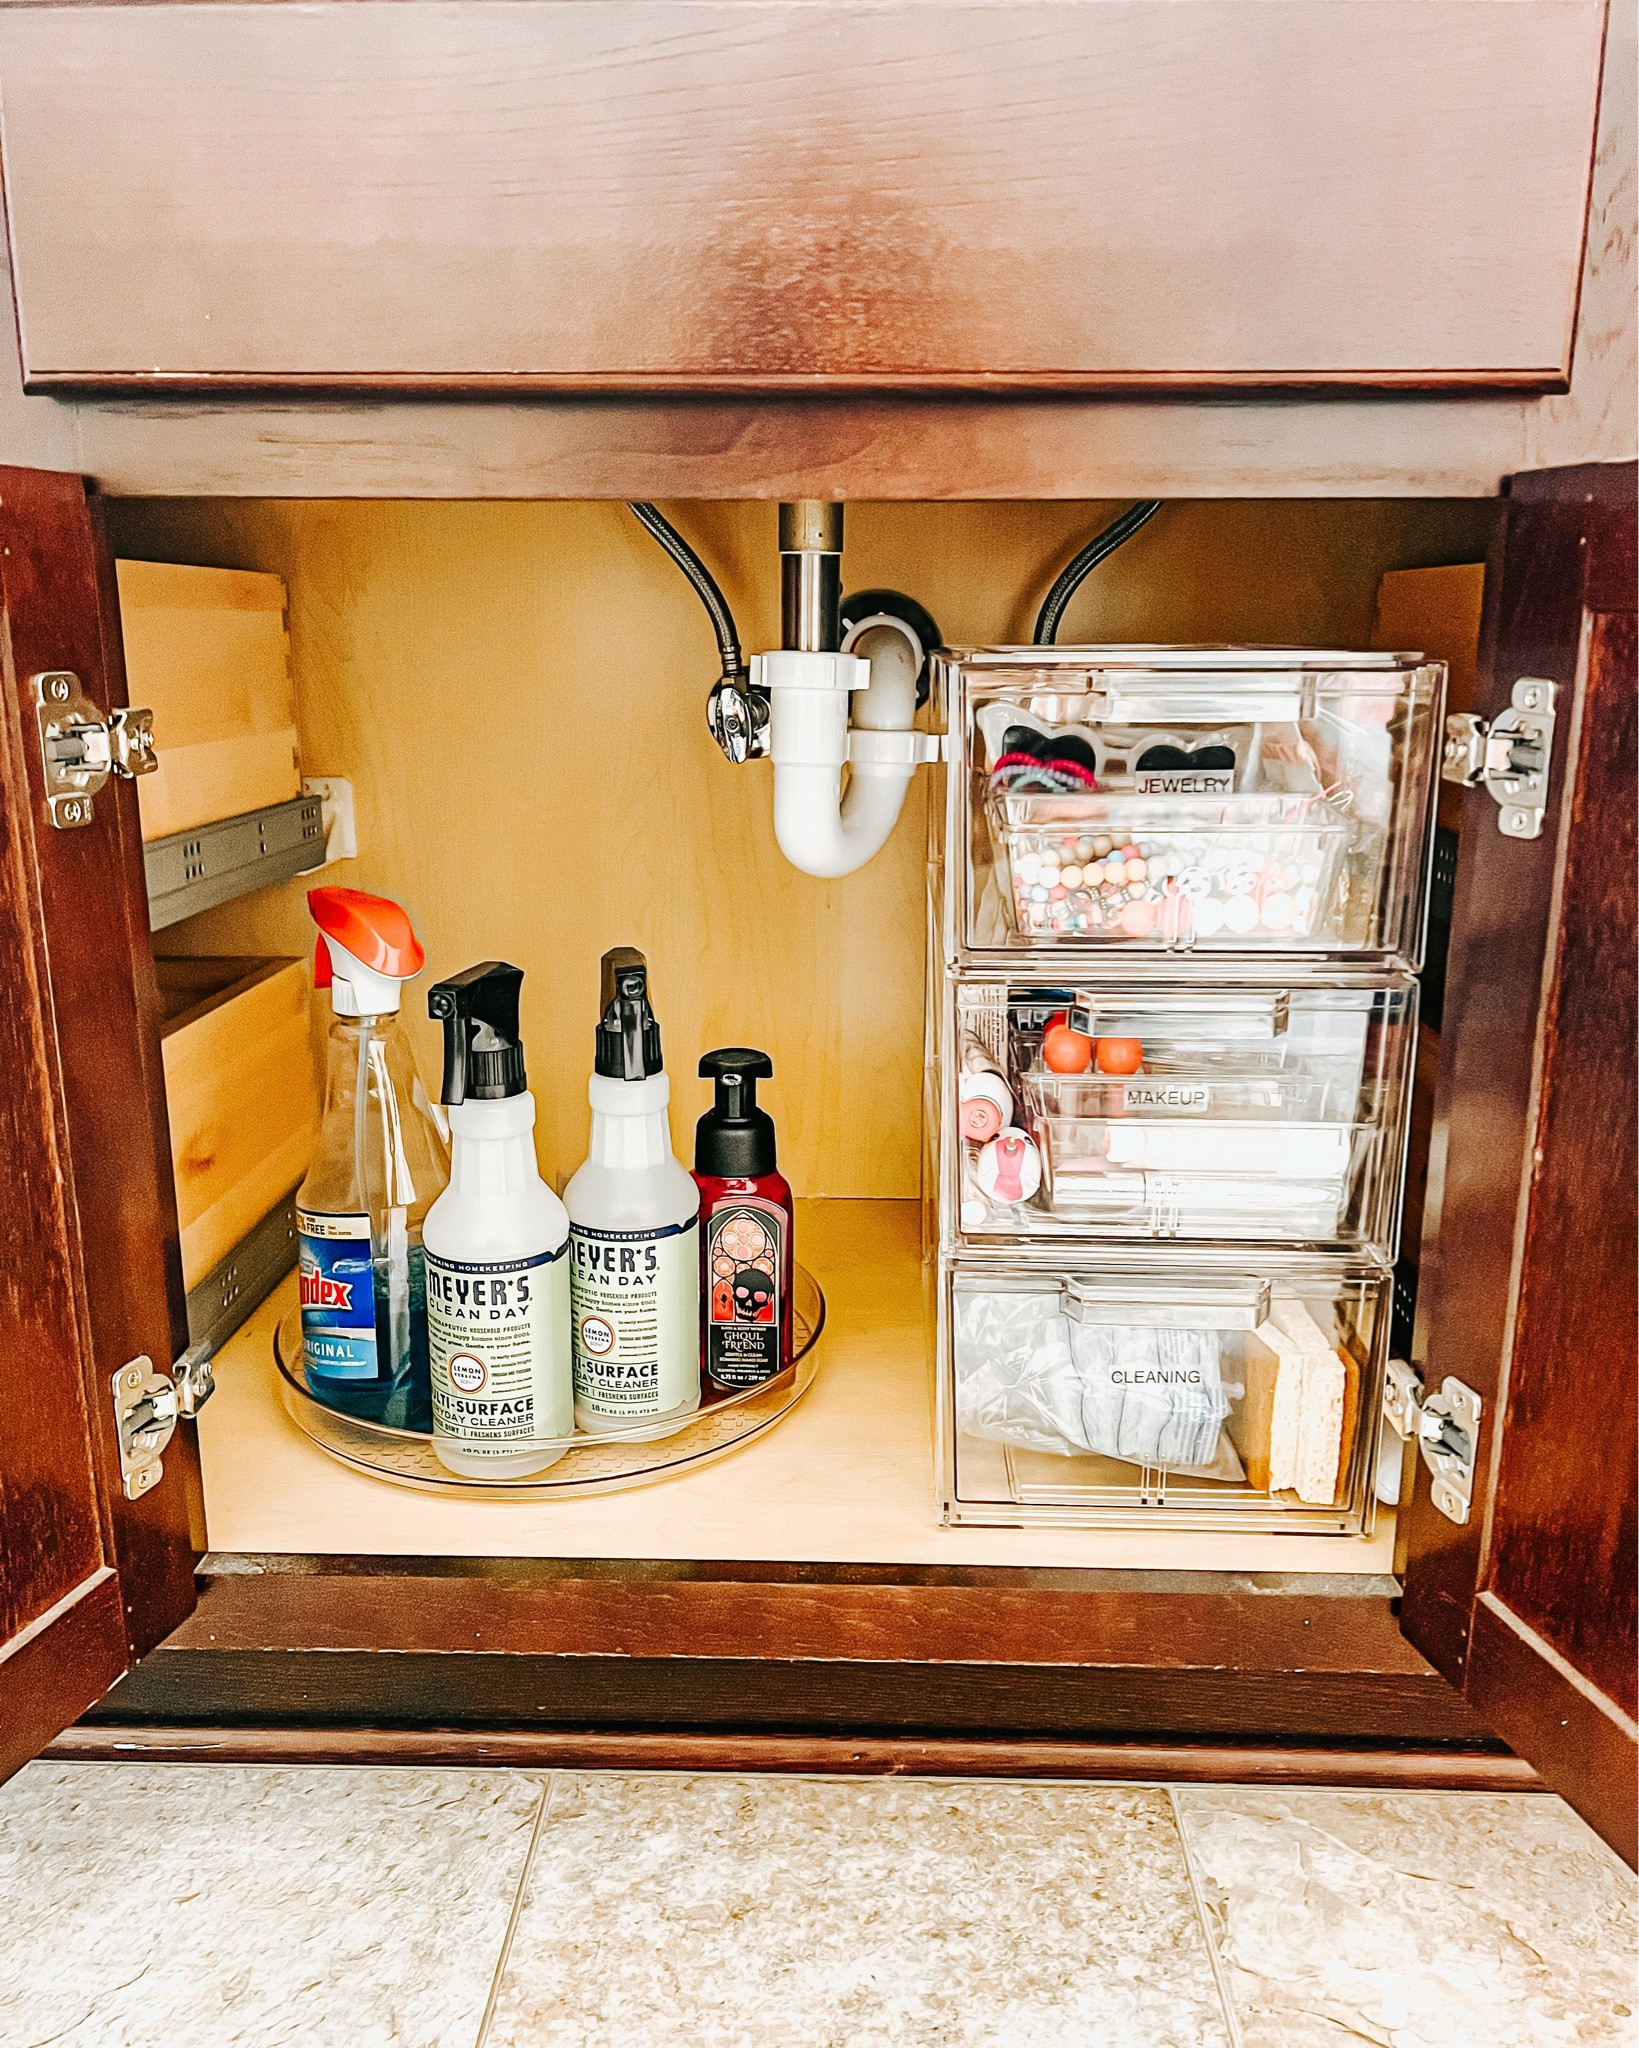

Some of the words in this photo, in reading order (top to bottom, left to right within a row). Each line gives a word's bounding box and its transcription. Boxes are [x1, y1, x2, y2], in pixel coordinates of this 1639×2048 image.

[1138, 777, 1230, 794] JEWELRY
[1127, 1090, 1205, 1105] MAKEUP
[306, 1223, 326, 1235] FREE
[591, 1231, 656, 1240] HOMEKEEPING
[459, 1261, 528, 1272] HOMEKEEPING
[618, 1274, 657, 1286] DAY
[631, 1290, 657, 1299] PRODUCTS
[430, 1297, 481, 1320] CLEAN
[490, 1304, 530, 1320] DAY
[503, 1322, 531, 1332] PRODUCTS
[584, 1328, 610, 1338] LEMON
[724, 1331, 764, 1341] GHOUL
[303, 1339, 355, 1358] RIGINAL
[721, 1340, 765, 1352] FRIEND
[453, 1365, 481, 1375] LEMON
[1111, 1370, 1200, 1384] CLEANING
[598, 1379, 658, 1389] CLEANER
[598, 1391, 628, 1401] FRESHENS
[629, 1391, 659, 1400] SURFACES
[470, 1413, 534, 1427] CLEANER
[470, 1430, 502, 1438] FRESHENS
[504, 1426, 535, 1438] SURFACES
